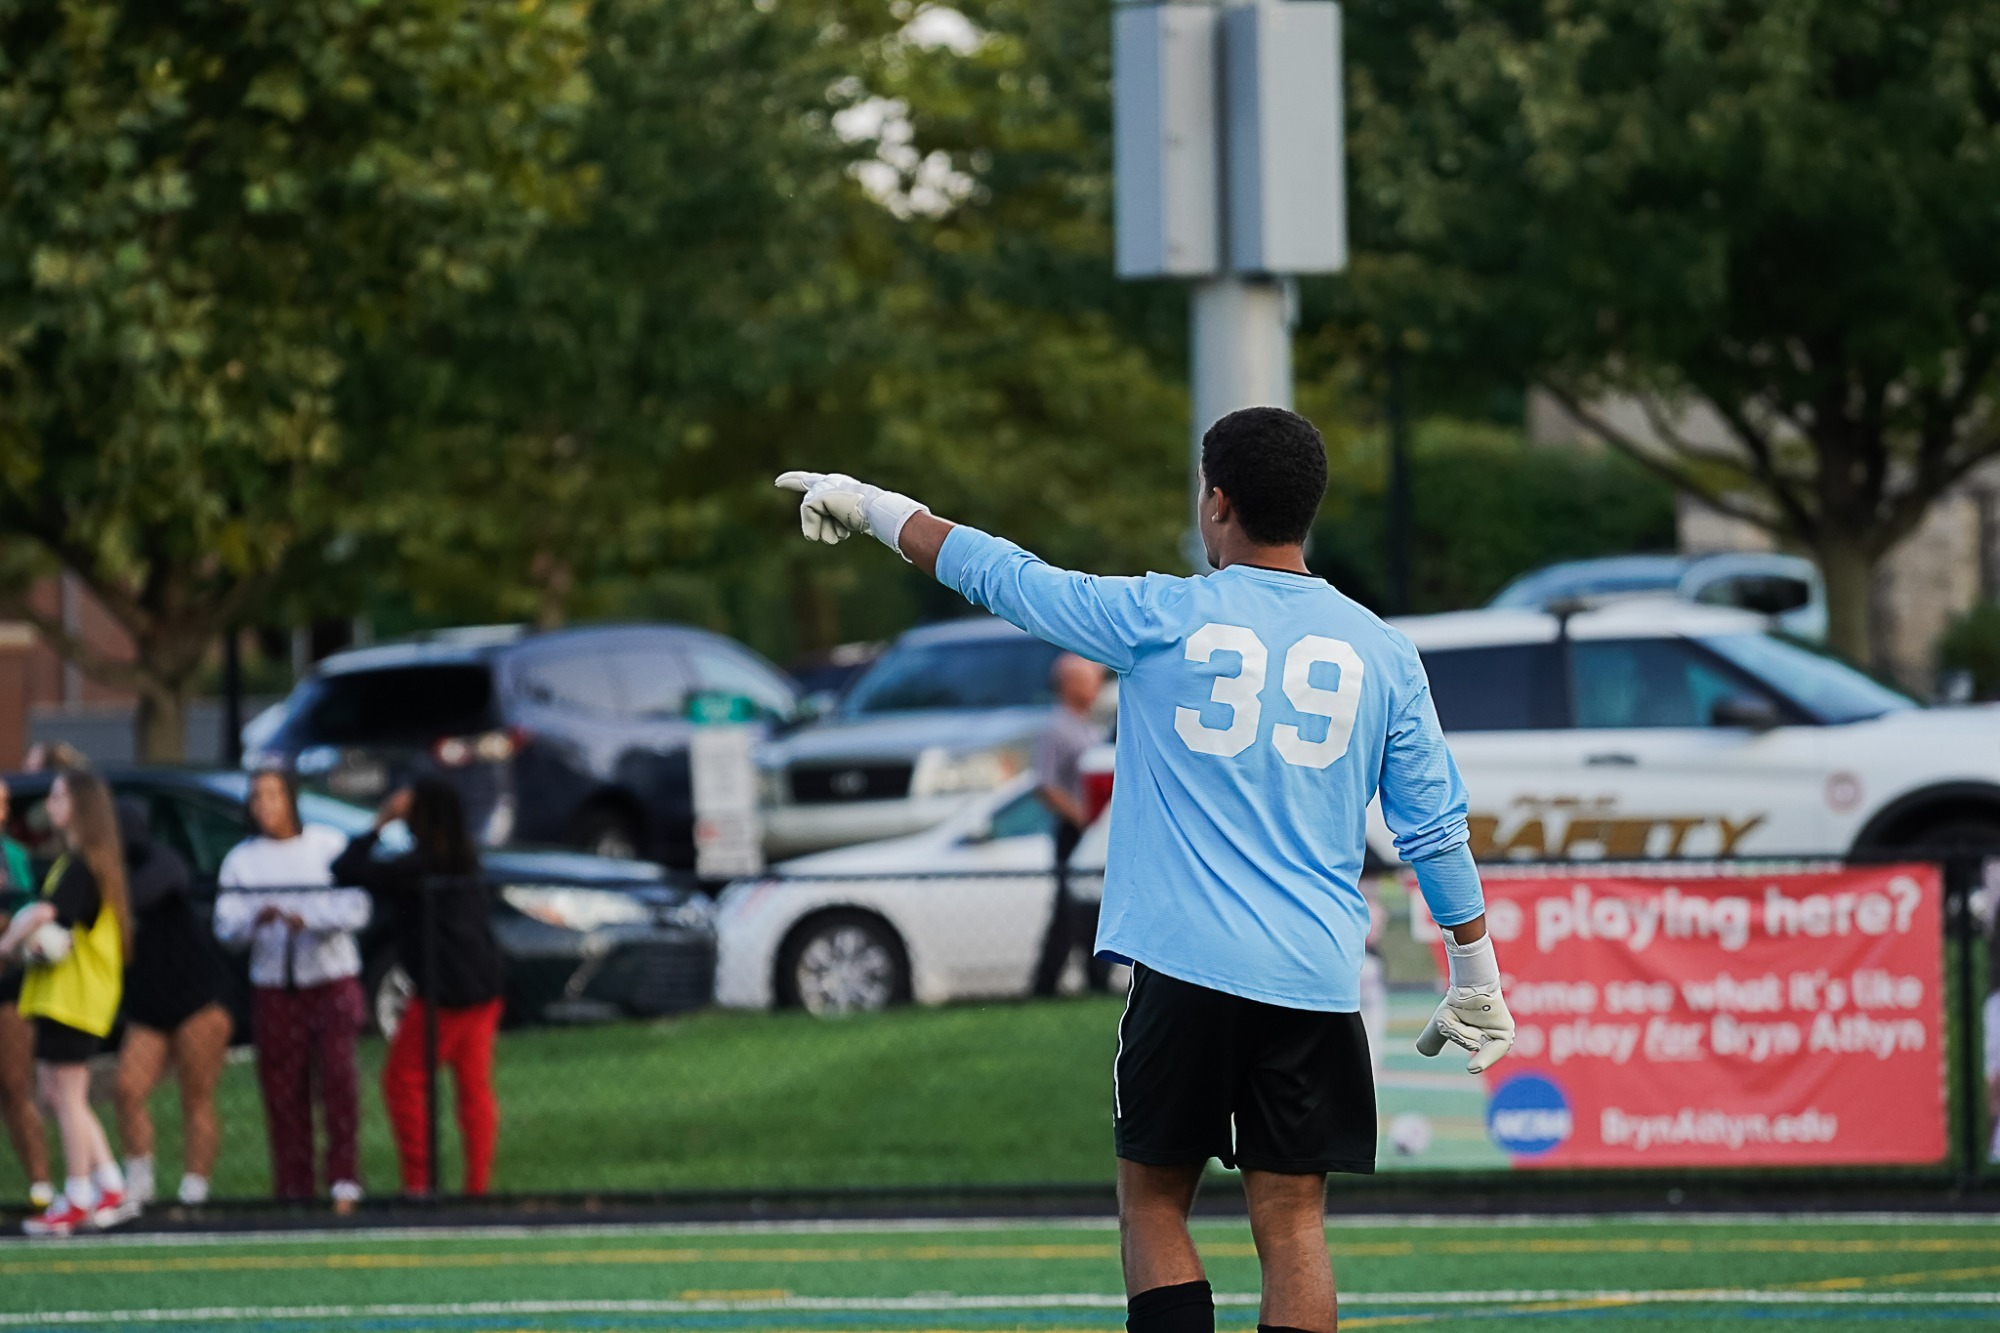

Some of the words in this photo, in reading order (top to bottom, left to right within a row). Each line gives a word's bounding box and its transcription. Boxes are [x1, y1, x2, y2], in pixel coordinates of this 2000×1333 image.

[1174, 623, 1365, 770] 39
[1410, 886, 1523, 943] Le
[1536, 884, 1749, 951] playing
[1763, 876, 1920, 935] here?
[1603, 978, 1675, 1015] see
[1680, 971, 1783, 1013] what
[1851, 967, 1924, 1010] like
[1507, 1021, 1546, 1058] o
[1549, 1017, 1641, 1066] play
[1643, 1014, 1706, 1063] for
[1711, 1013, 1801, 1062] Bryn
[1809, 1012, 1925, 1060] Athyn
